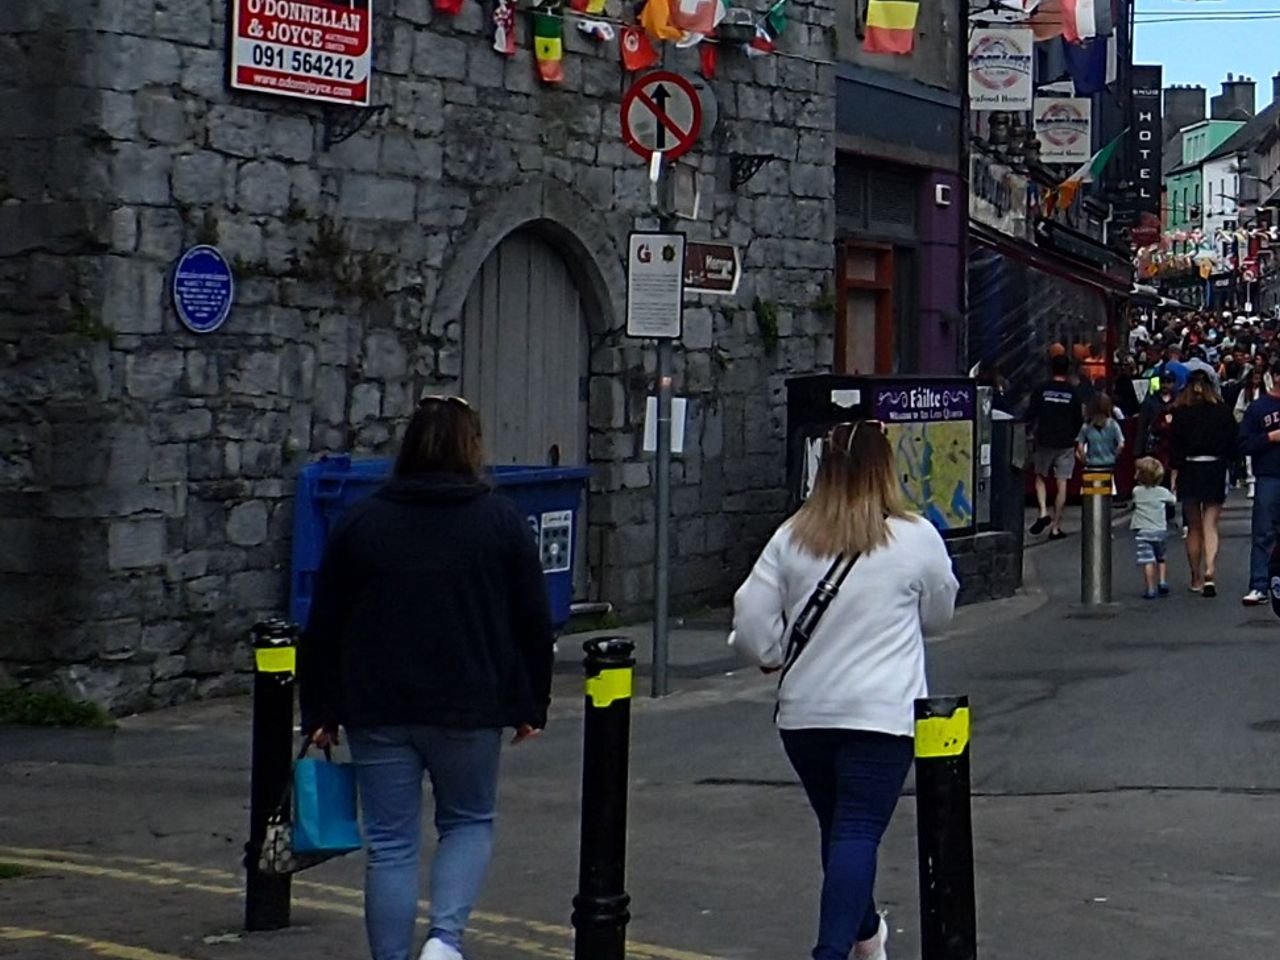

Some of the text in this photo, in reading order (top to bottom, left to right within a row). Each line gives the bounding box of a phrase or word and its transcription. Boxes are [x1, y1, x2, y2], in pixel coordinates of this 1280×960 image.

[247, 18, 264, 38] &
[267, 21, 323, 48] JOYCE
[253, 44, 354, 80] 091 564212
[1139, 111, 1151, 198] HOTEL
[910, 387, 941, 408] Fáilte
